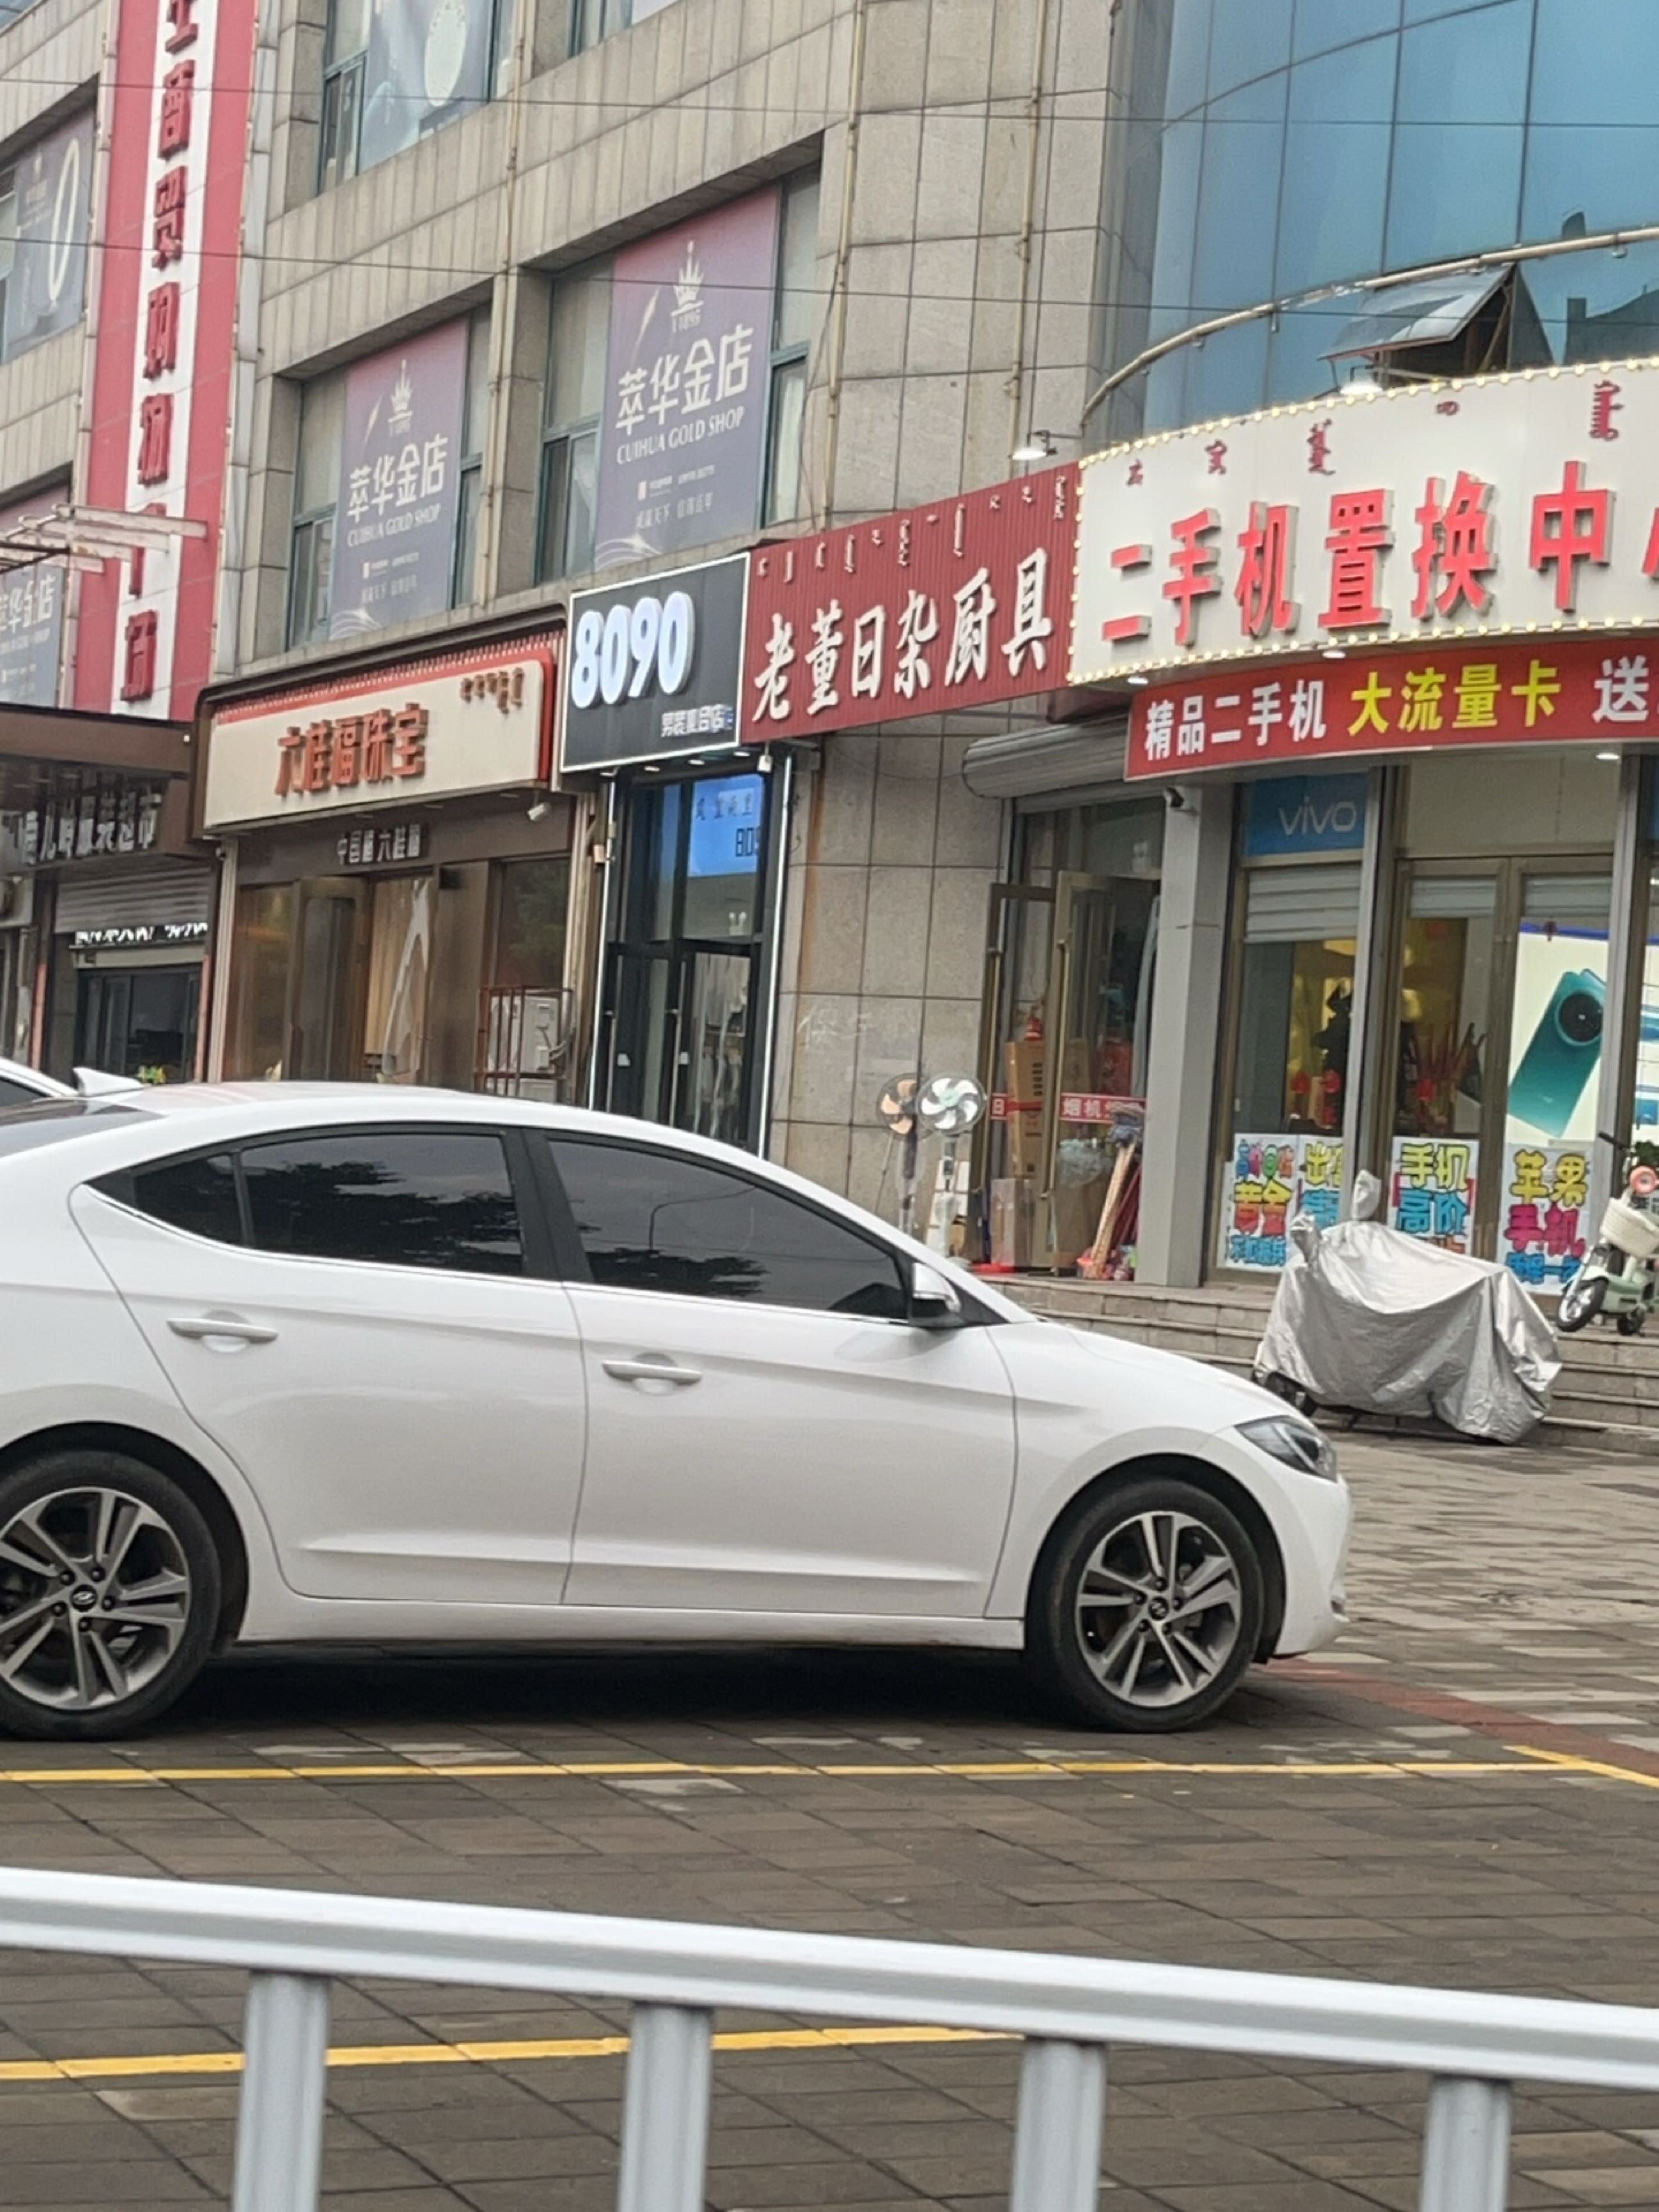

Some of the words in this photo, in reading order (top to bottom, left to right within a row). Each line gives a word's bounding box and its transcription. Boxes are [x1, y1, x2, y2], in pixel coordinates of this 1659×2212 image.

[615, 323, 754, 436] 萃华金店
[346, 433, 448, 524] 萃华金店
[616, 433, 666, 465] CUIHUA
[668, 419, 706, 449] GOLD
[708, 405, 745, 437] SHOP
[1102, 460, 1659, 646] 二手机置换中
[570, 590, 696, 709] 8090
[752, 547, 1054, 723] 老董日杂厨具
[1144, 678, 1327, 761] 精品二手机
[1347, 659, 1562, 735] 大流量卡
[1278, 796, 1357, 836] vivo
[1396, 1187, 1468, 1237] 高价
[1400, 1142, 1470, 1192] 手机
[1508, 1148, 1589, 1207] 苹果
